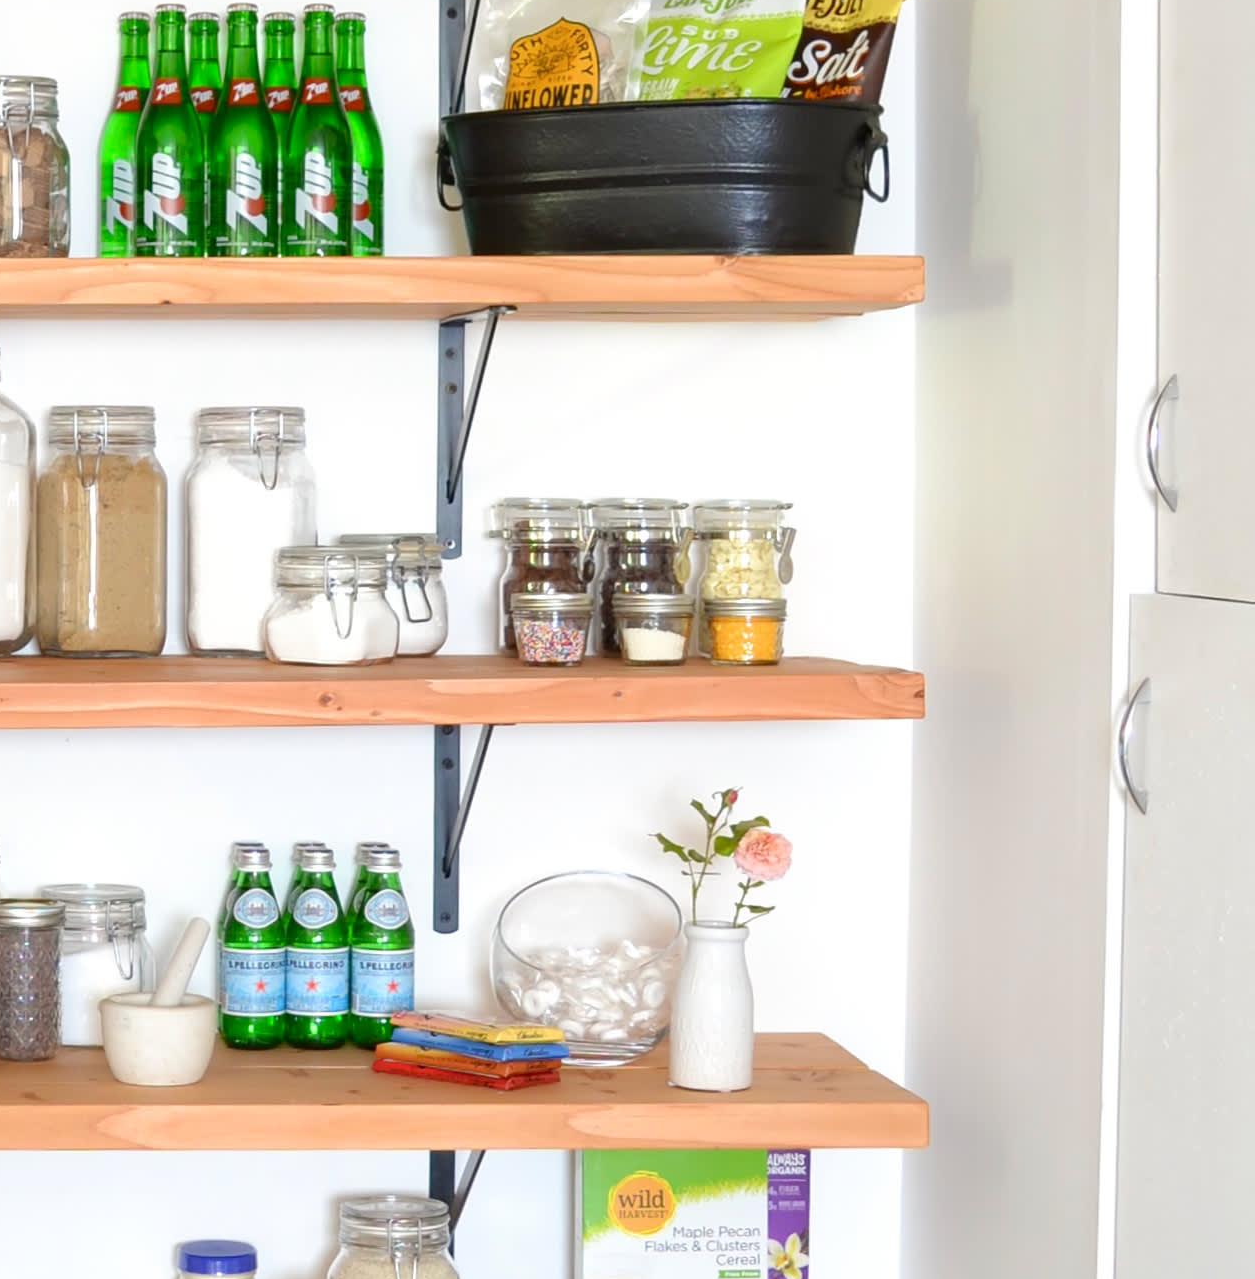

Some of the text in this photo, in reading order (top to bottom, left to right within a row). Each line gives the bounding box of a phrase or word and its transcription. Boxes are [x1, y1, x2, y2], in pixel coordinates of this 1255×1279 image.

[681, 24, 739, 41] SUB
[569, 28, 594, 76] FORTY
[786, 29, 870, 86] Salt
[618, 1189, 665, 1209] wild
[618, 1209, 666, 1219] HARVEST
[672, 1225, 761, 1239] Maple Pecan
[644, 1239, 761, 1253] Flakes & Clusters
[716, 1253, 761, 1266] Cereal
